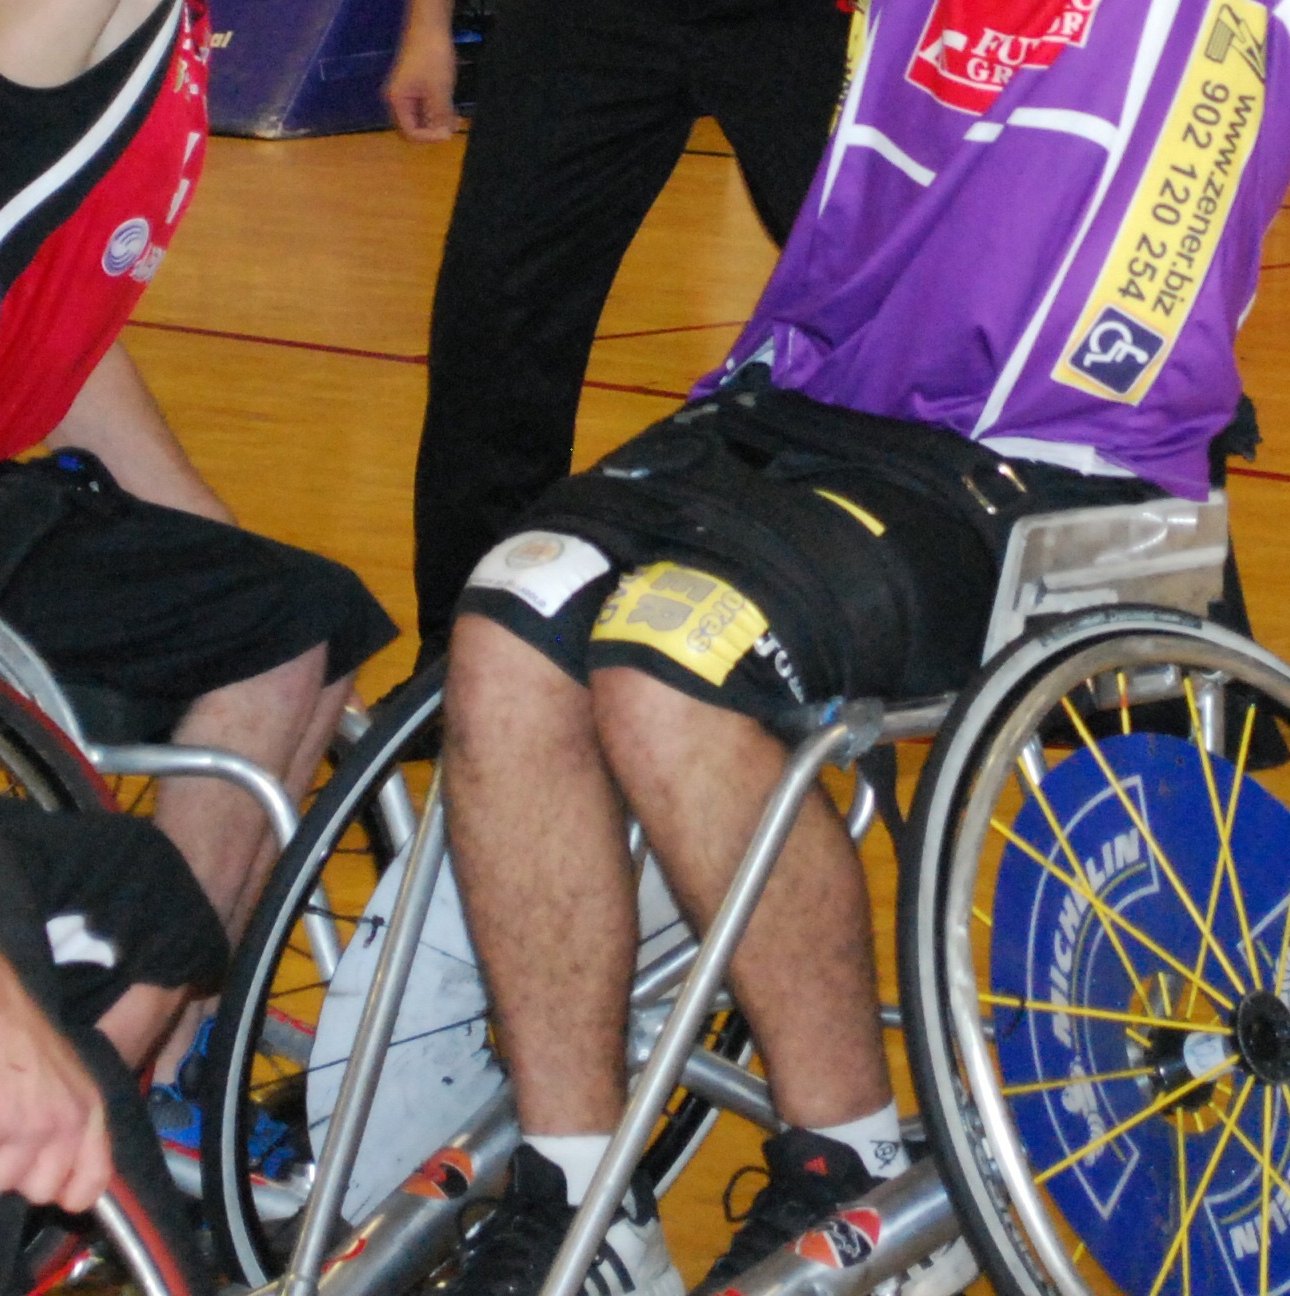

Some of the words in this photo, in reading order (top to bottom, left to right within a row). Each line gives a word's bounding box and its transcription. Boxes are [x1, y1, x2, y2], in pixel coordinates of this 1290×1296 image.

[1182, 80, 1230, 150] 902
[1151, 93, 1257, 318] www.zener.biz
[1152, 163, 1199, 226] 120
[1118, 236, 1168, 304] 254
